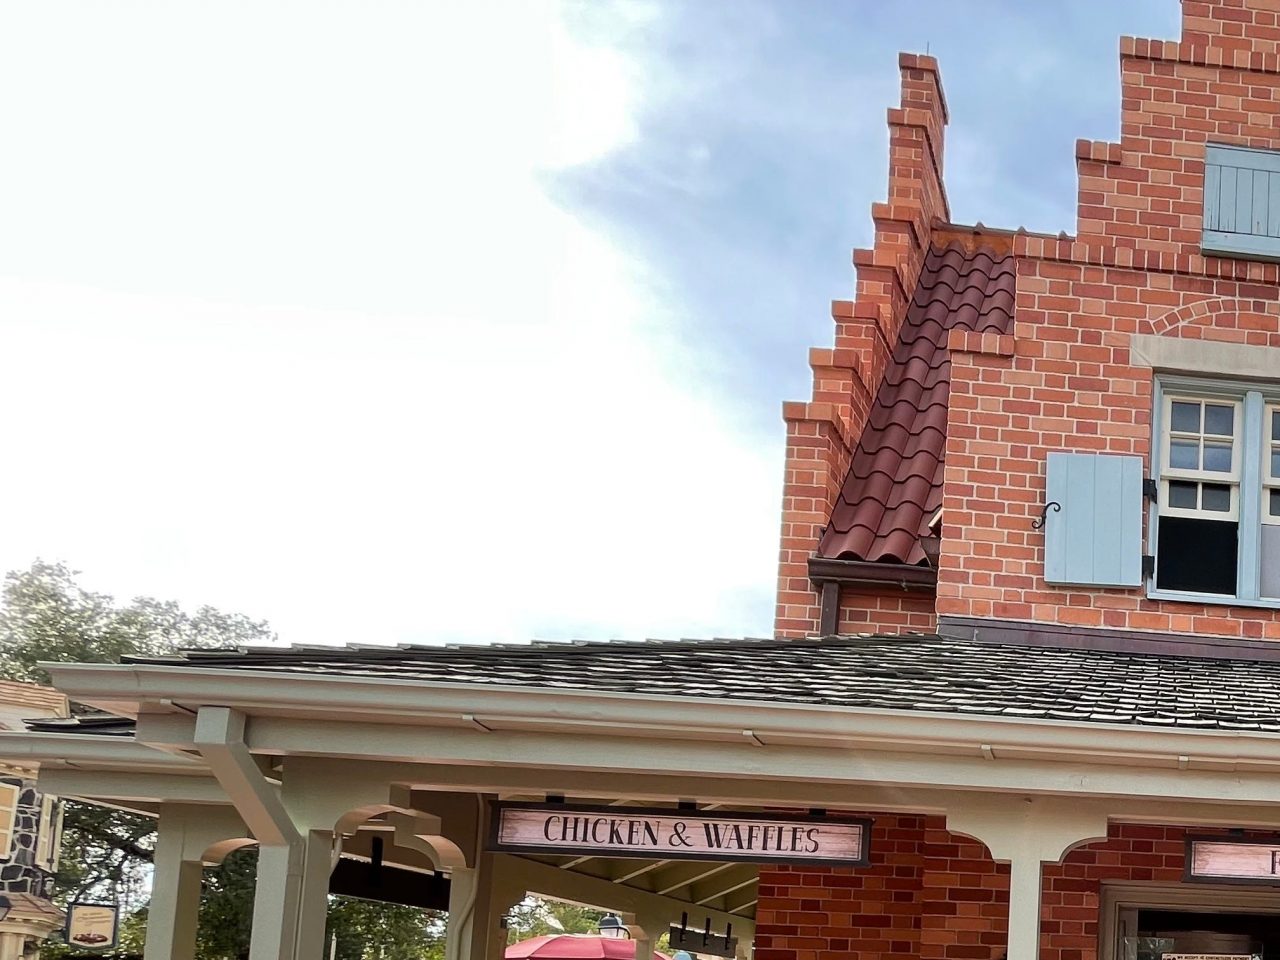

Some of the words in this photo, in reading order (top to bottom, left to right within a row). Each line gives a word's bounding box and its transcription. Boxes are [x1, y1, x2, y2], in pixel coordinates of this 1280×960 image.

[543, 815, 661, 846] CHICKEN
[668, 821, 694, 847] &
[702, 822, 820, 853] WAFFLES
